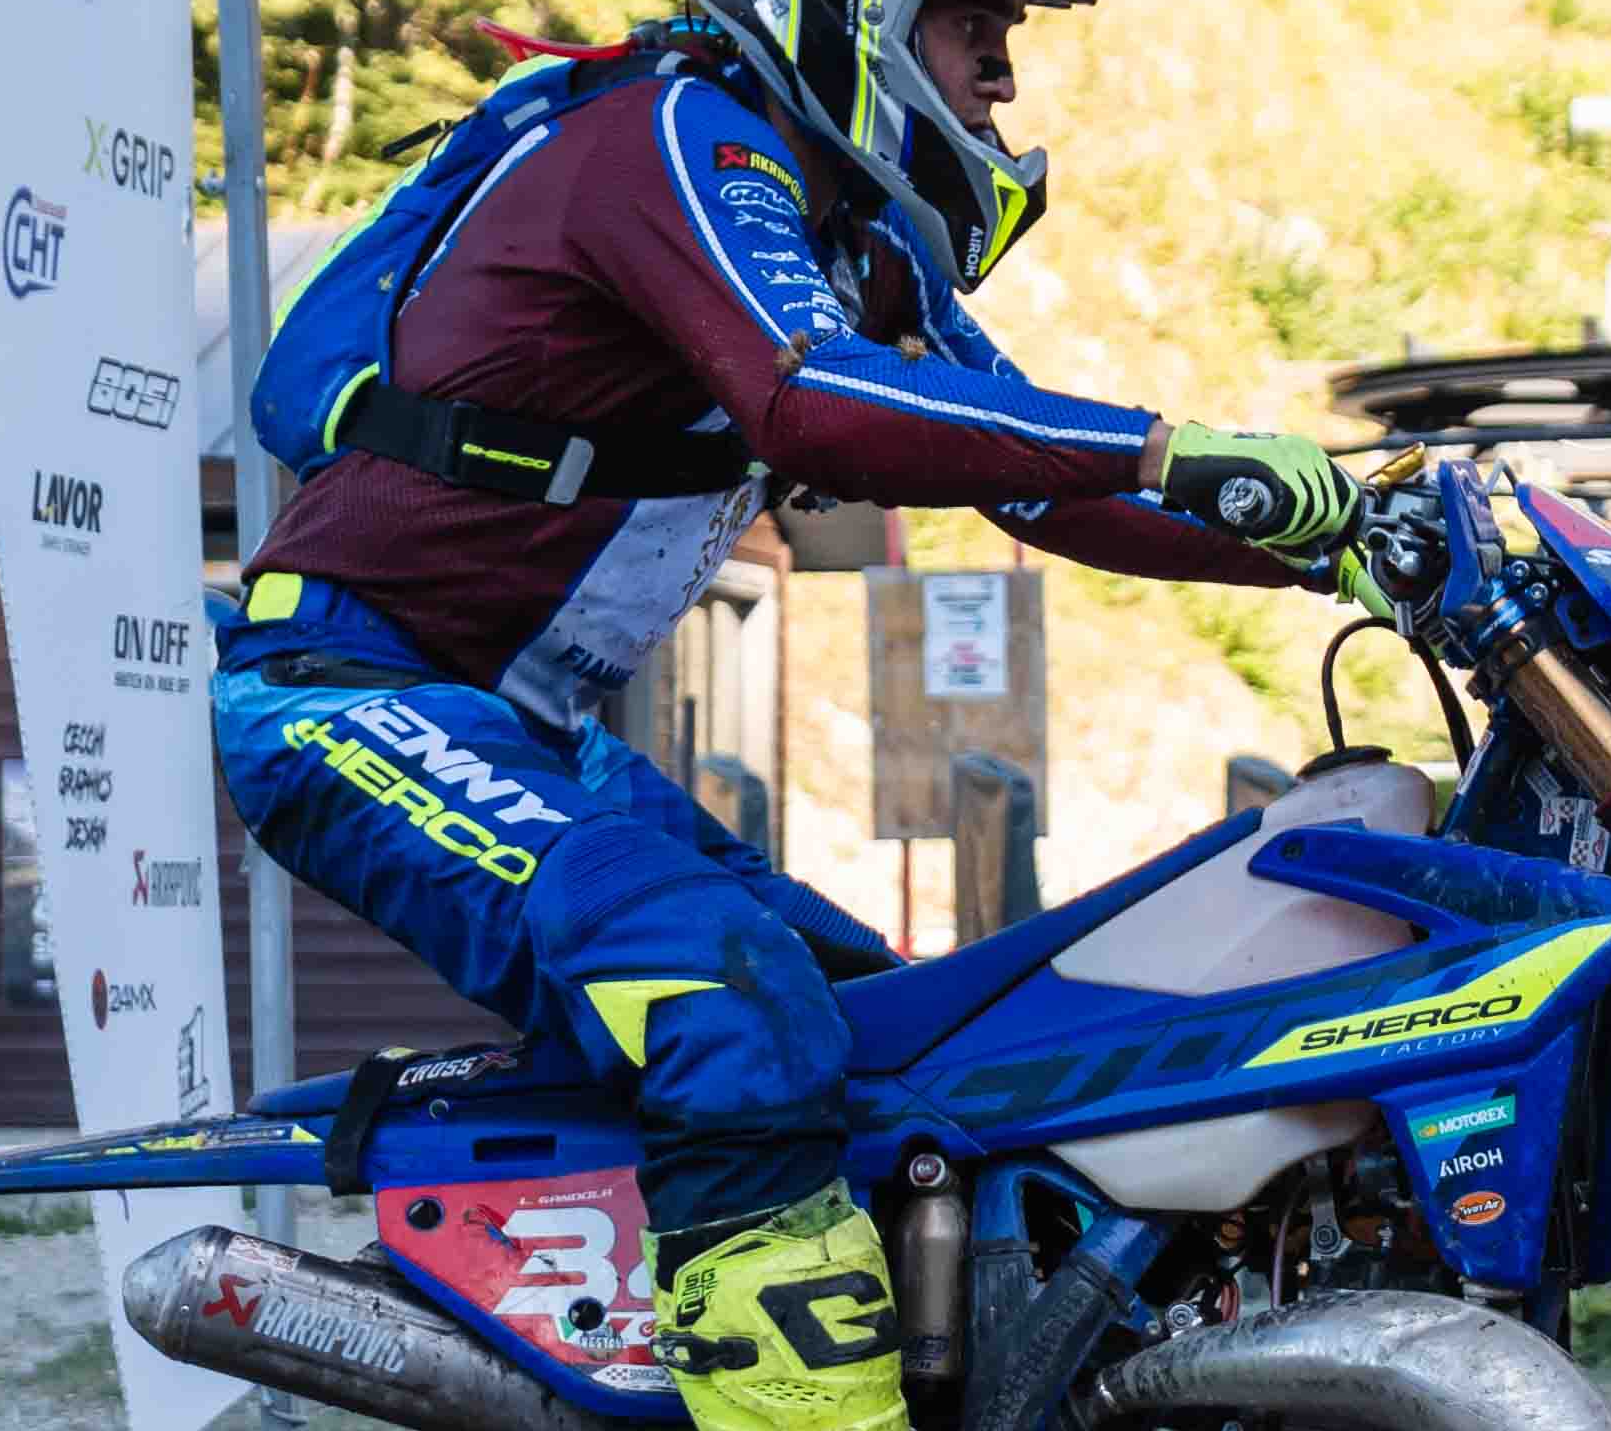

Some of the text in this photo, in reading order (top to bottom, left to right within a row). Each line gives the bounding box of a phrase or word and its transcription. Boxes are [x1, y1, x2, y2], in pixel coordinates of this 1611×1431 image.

[965, 224, 984, 277] AIROH
[32, 469, 104, 534] LAVOR
[114, 614, 190, 666] ON OFF
[108, 982, 158, 1013] 24MX
[1300, 994, 1523, 1052] SHERCO
[1380, 1026, 1504, 1058] FACTORY
[1437, 1104, 1509, 1135] MOTOREX
[1439, 1147, 1505, 1178] AIROH
